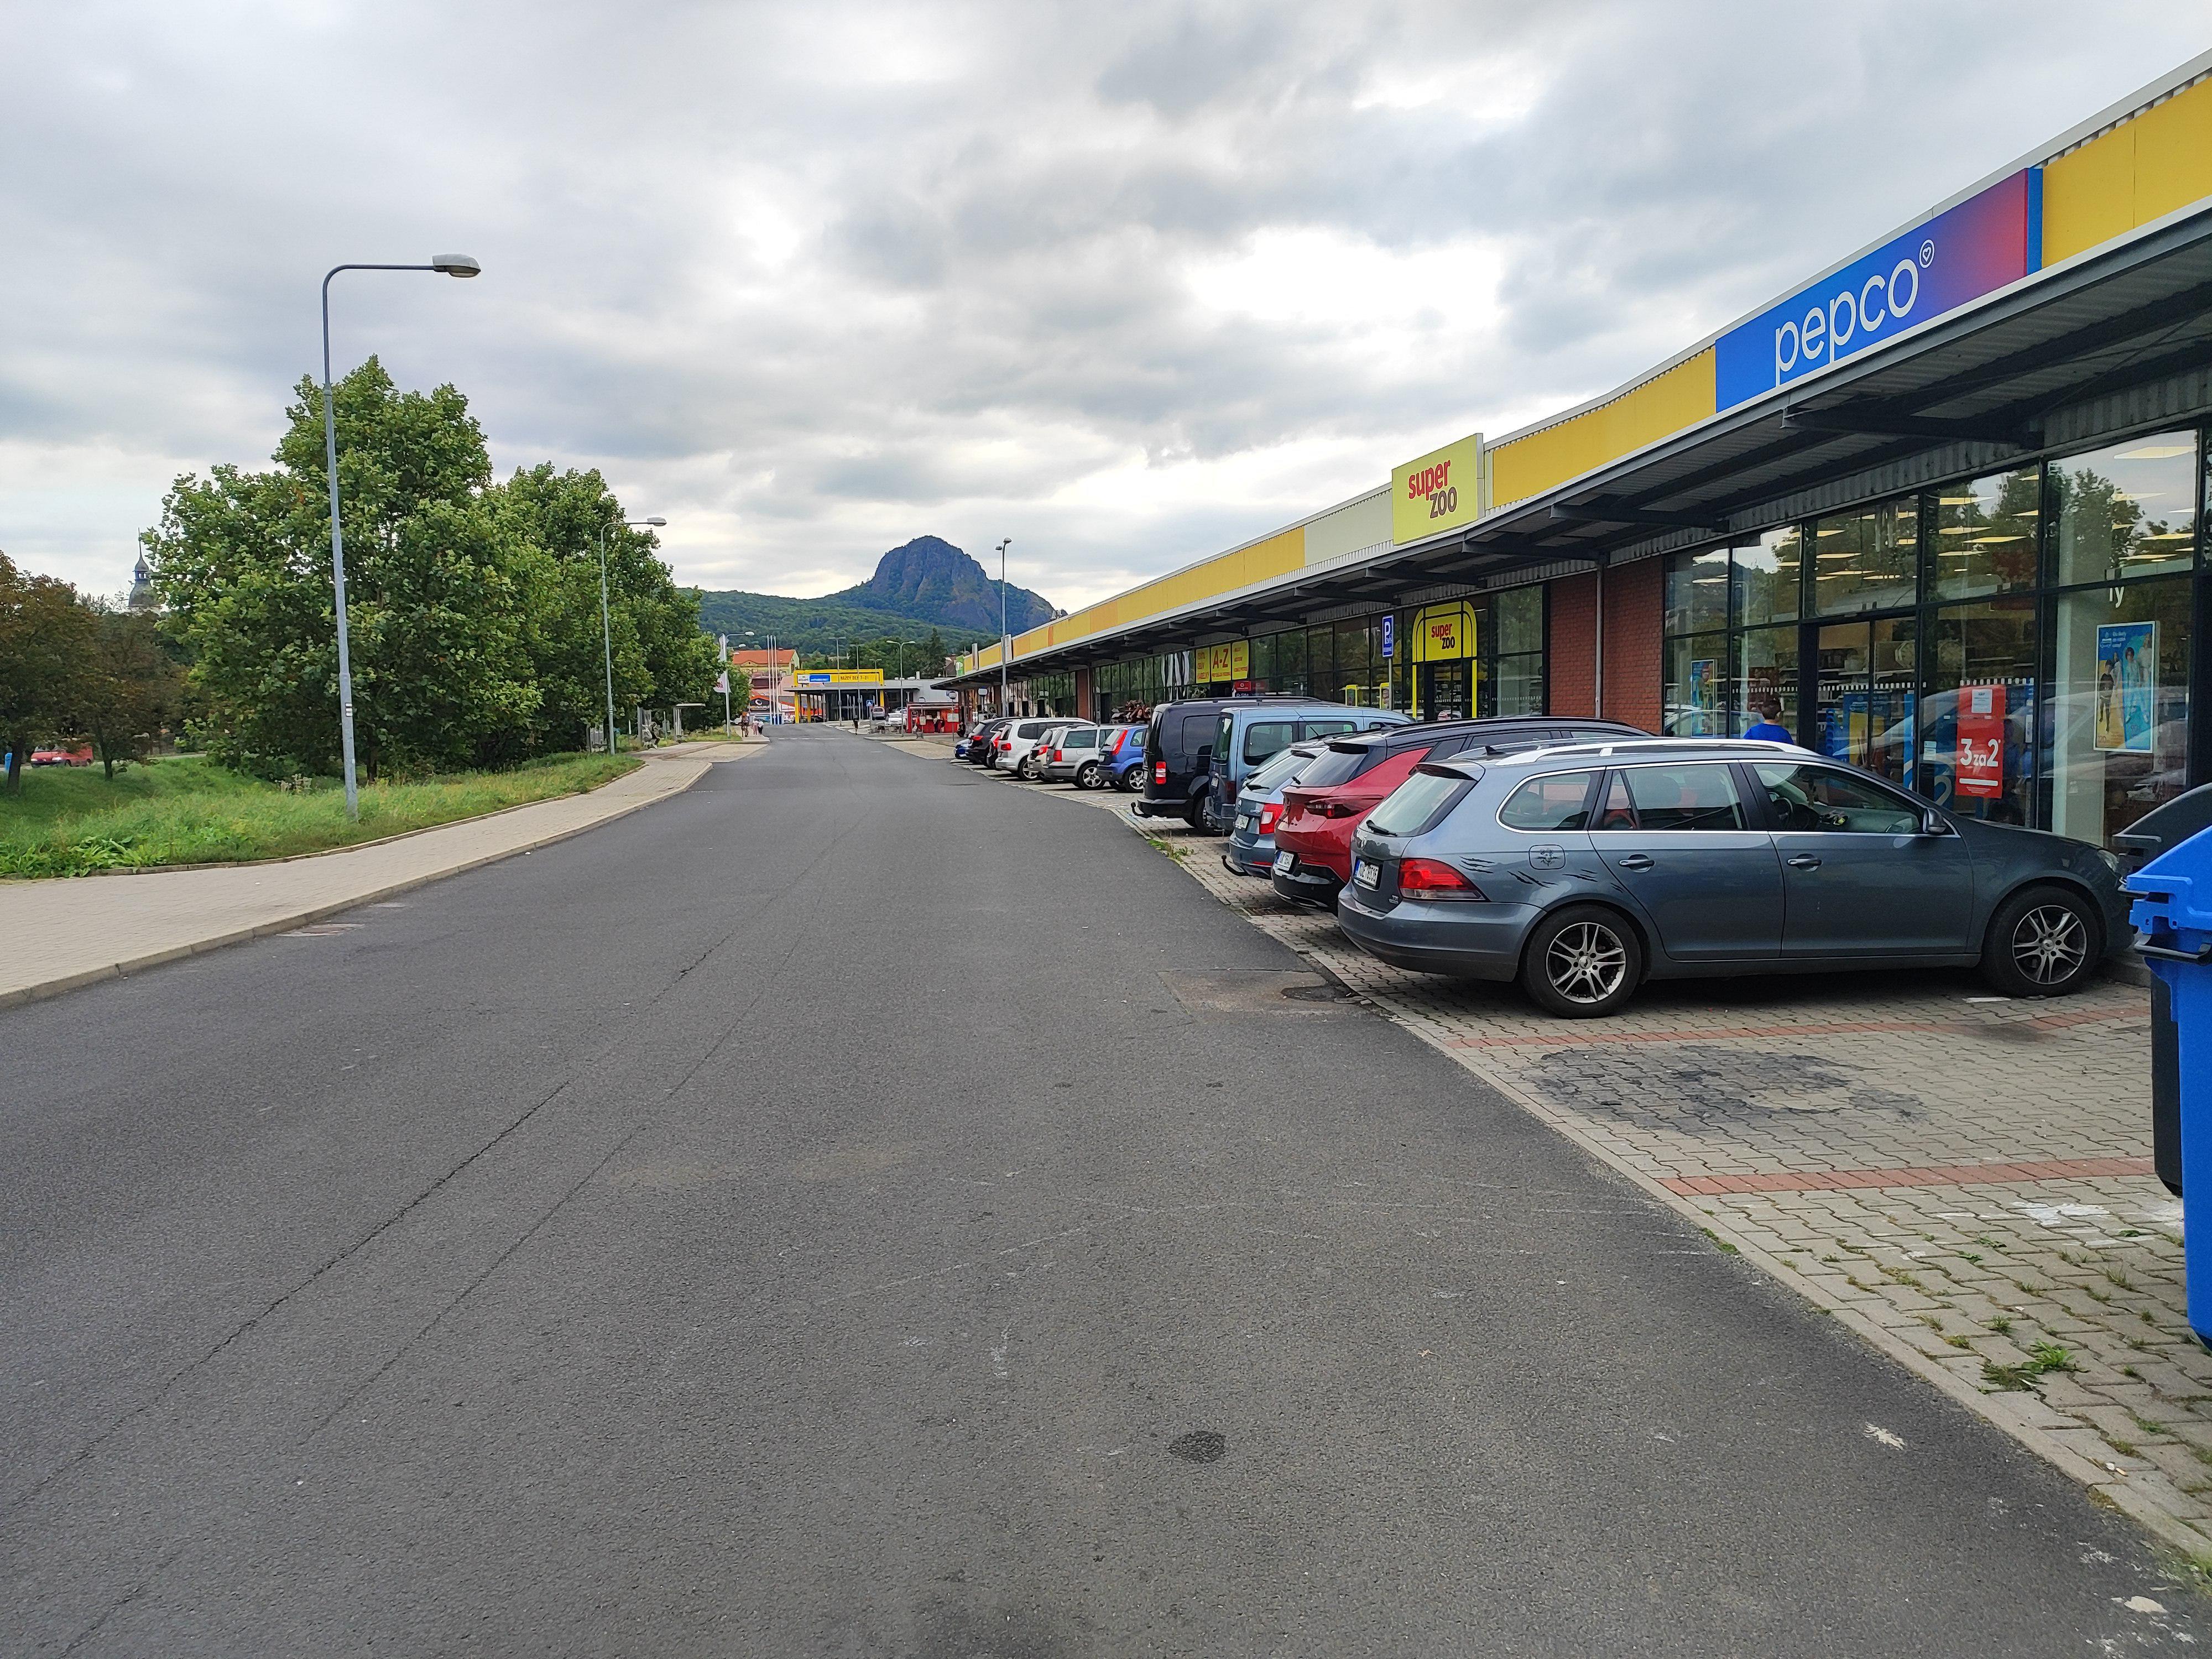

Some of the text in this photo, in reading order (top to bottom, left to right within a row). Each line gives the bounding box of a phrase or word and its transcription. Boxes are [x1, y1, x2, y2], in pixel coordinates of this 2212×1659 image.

[1775, 259, 1918, 387] pepco
[1408, 460, 1451, 501] super
[1431, 623, 1453, 640] super
[1960, 738, 1973, 766] 3
[1973, 753, 1986, 766] za
